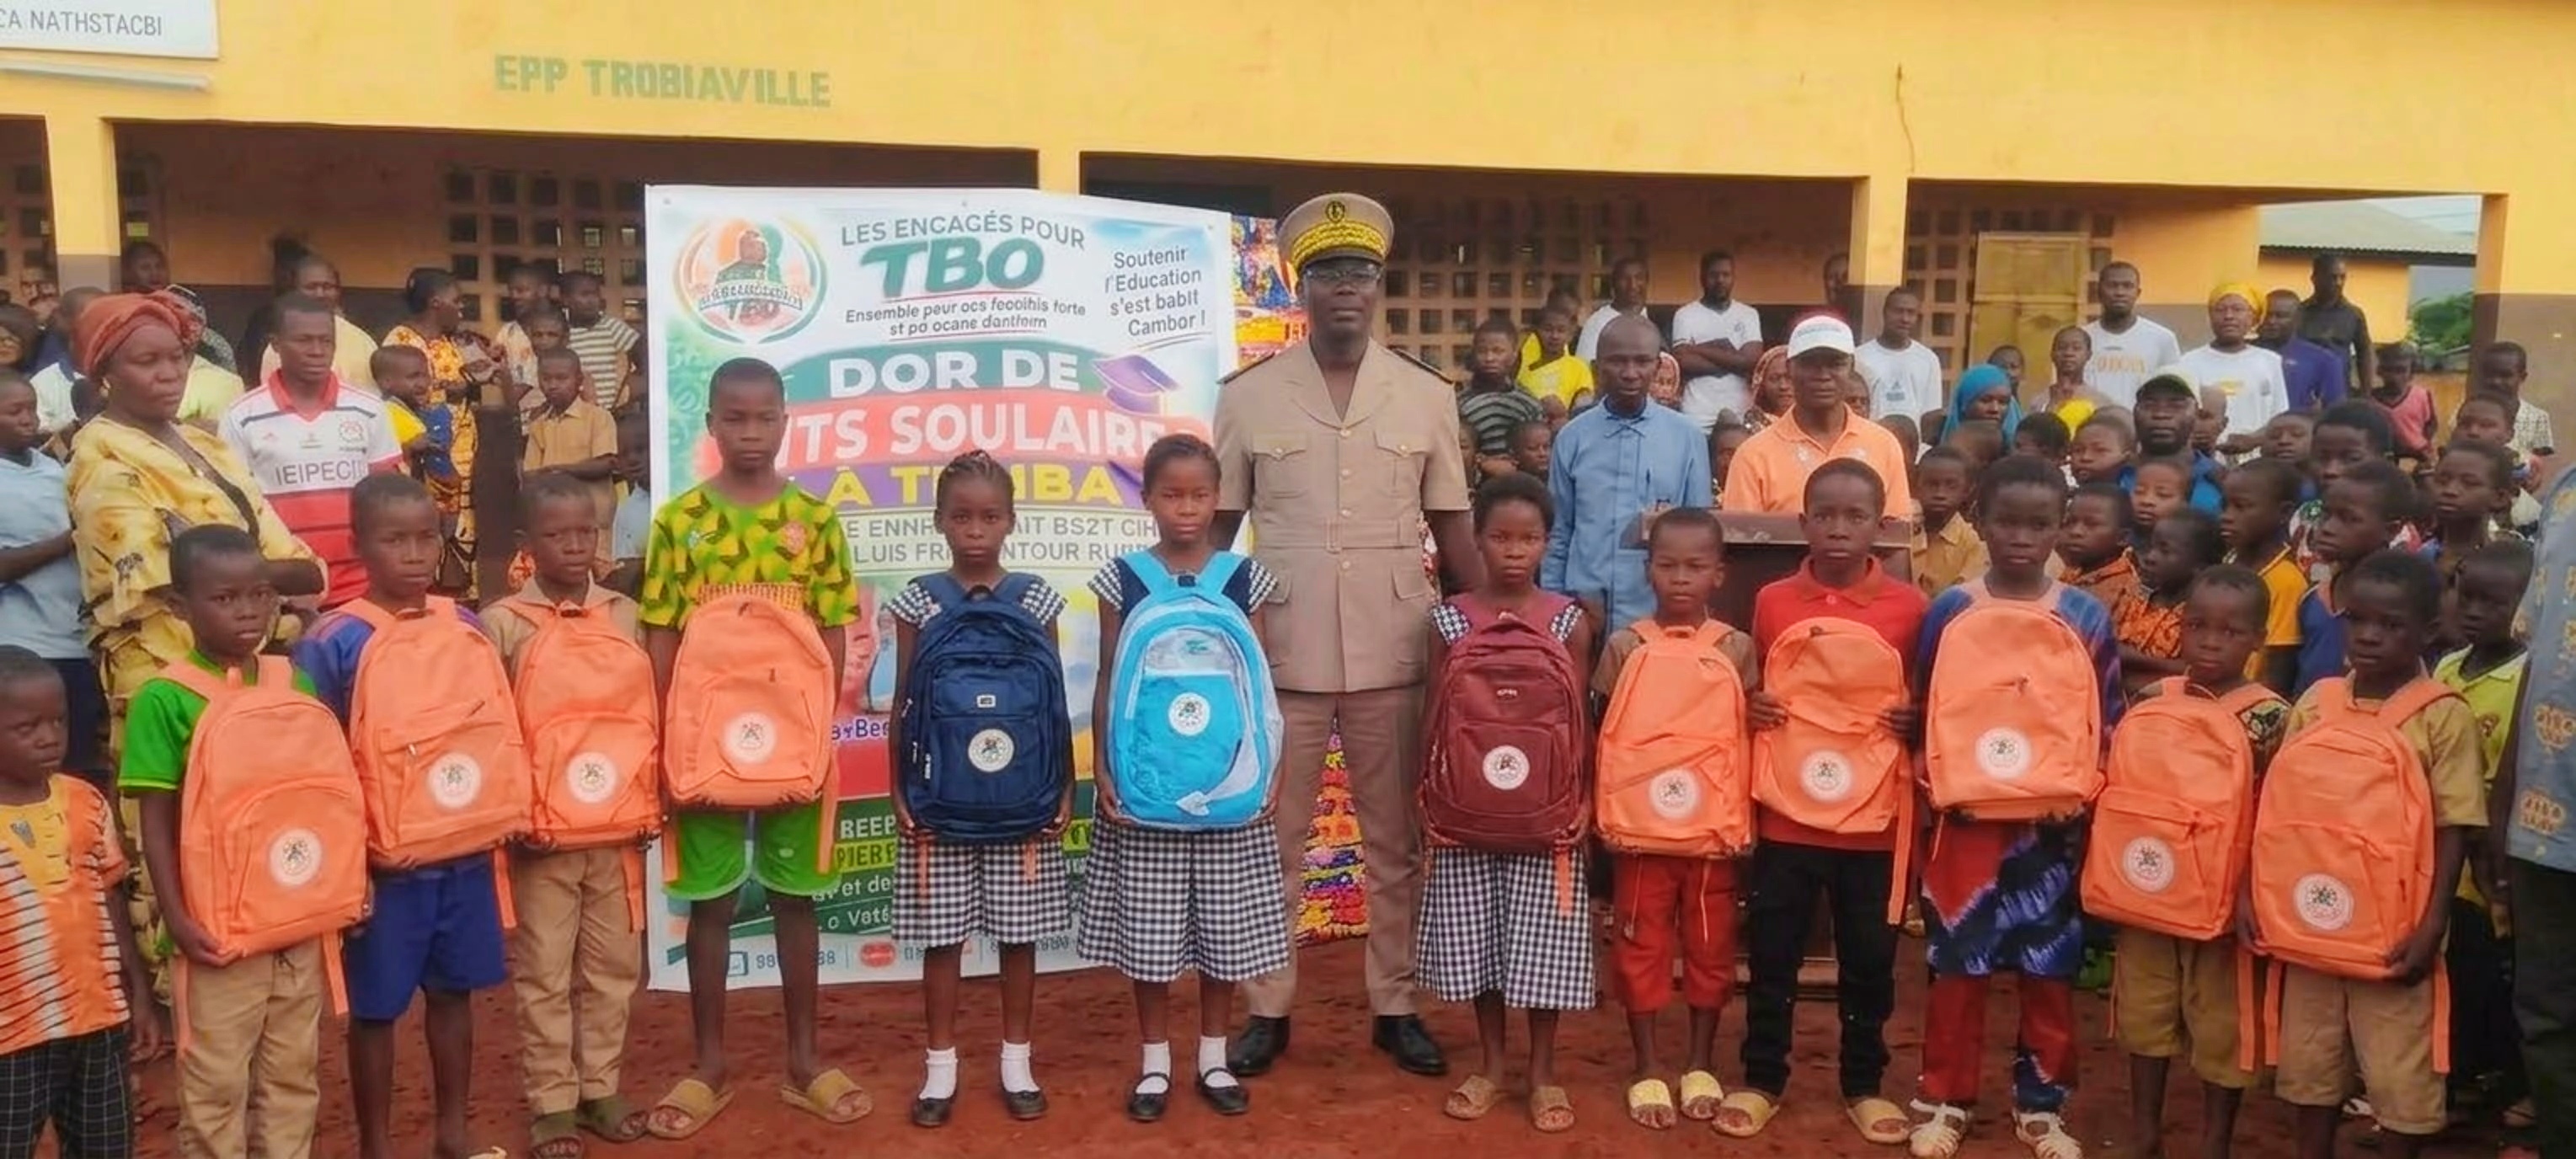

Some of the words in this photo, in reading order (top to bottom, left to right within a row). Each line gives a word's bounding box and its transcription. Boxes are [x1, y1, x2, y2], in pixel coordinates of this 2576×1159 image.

[494, 55, 567, 92] EPP
[582, 59, 831, 107] TROBIAVILLE
[842, 222, 886, 246] LES
[1021, 216, 1085, 250] POUR
[860, 237, 1045, 298] TBO
[1114, 245, 1187, 269] Soutenir
[846, 304, 919, 323] Ensemble
[1110, 296, 1151, 316] s'est
[829, 350, 979, 398] DOR
[1002, 350, 1080, 392] DE
[890, 464, 1123, 505] TBA
